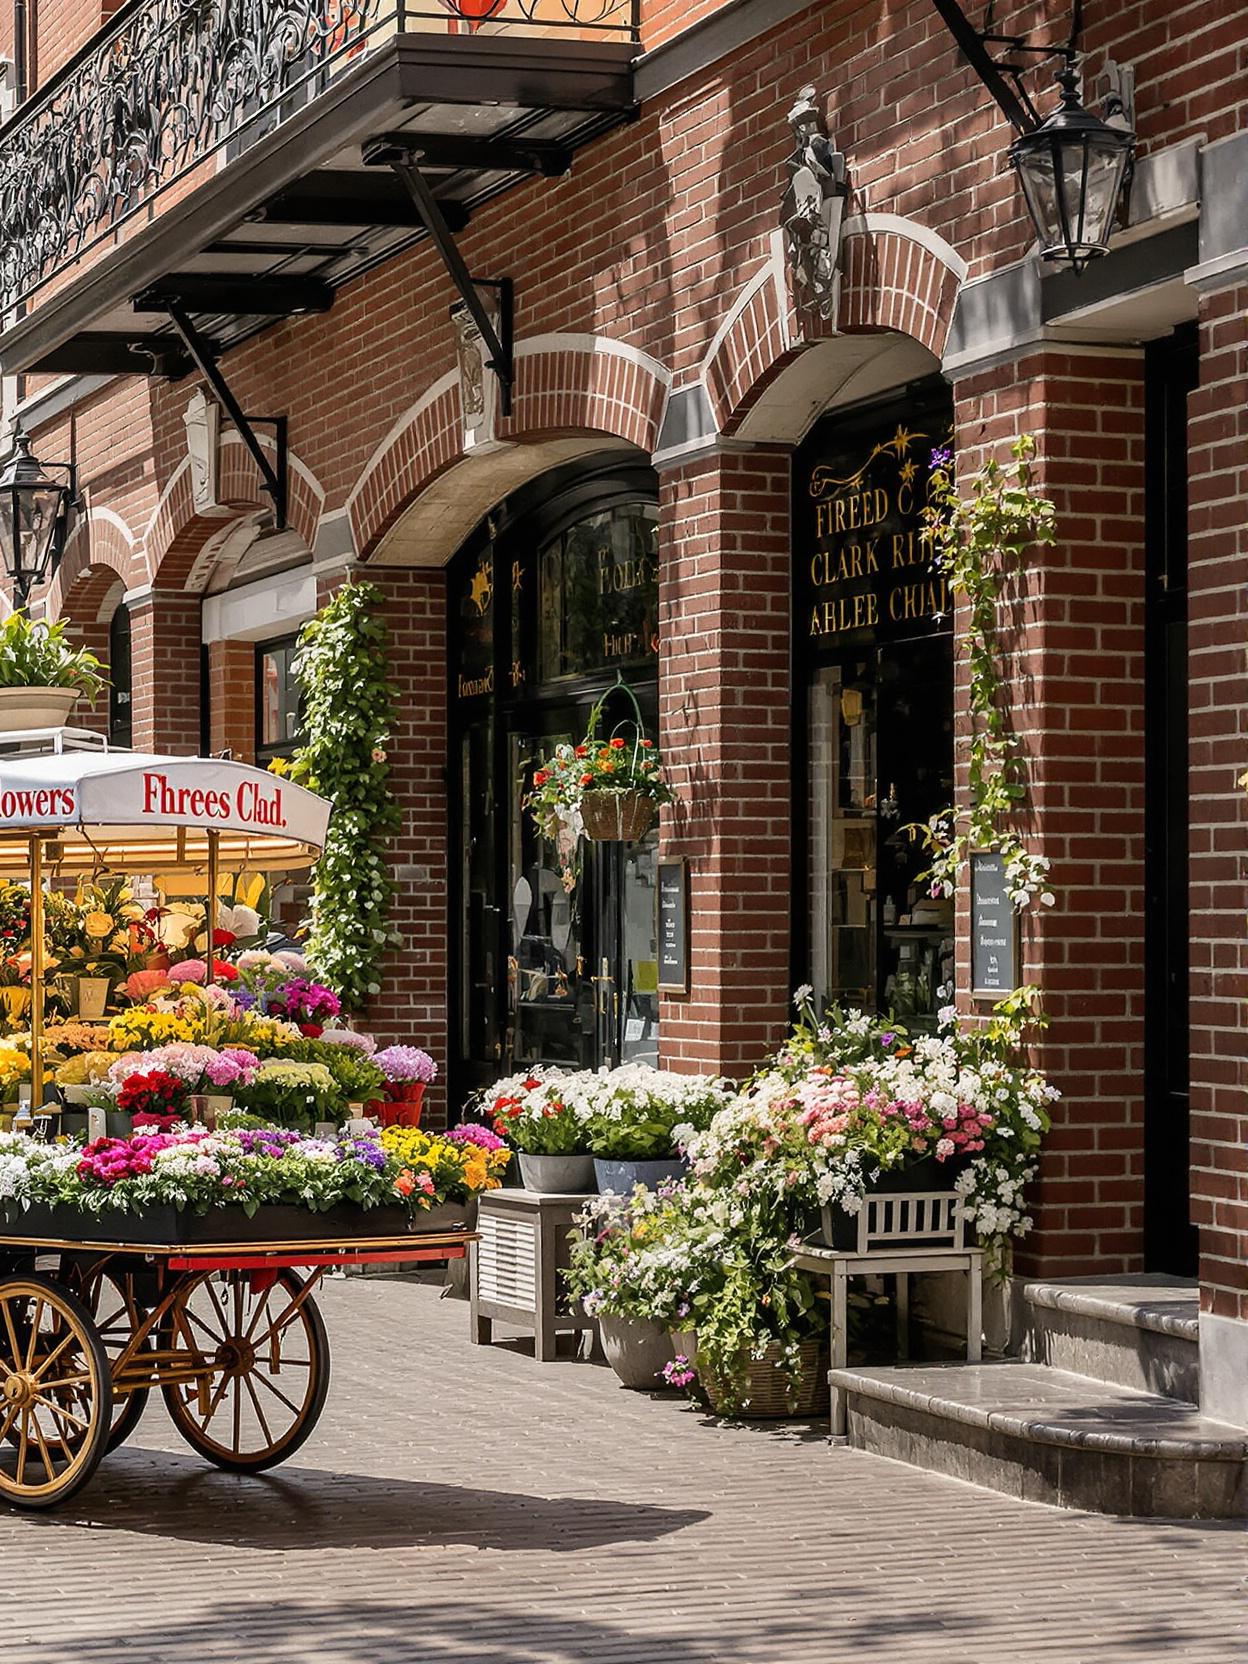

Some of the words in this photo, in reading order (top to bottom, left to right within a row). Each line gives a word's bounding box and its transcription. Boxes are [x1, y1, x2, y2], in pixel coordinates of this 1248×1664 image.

[816, 488, 888, 538] FIREED
[811, 540, 879, 586] CLARK
[142, 772, 231, 820] Fhrees
